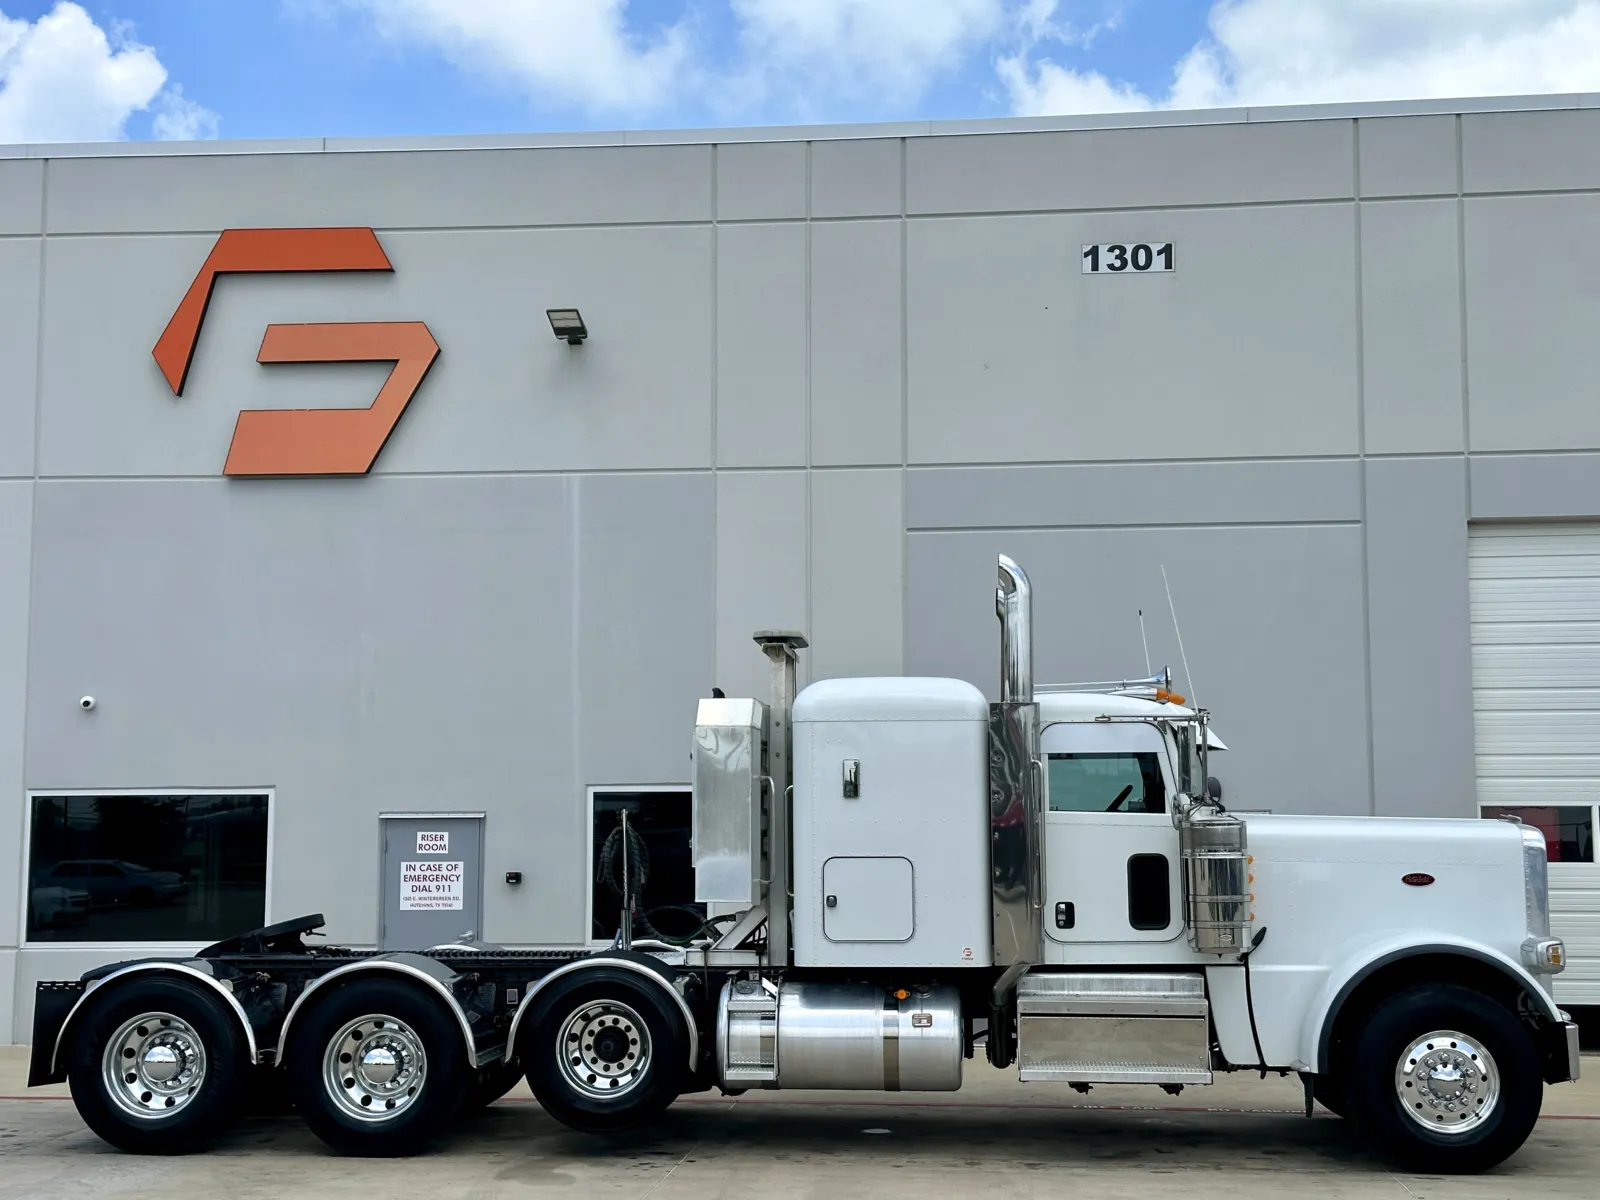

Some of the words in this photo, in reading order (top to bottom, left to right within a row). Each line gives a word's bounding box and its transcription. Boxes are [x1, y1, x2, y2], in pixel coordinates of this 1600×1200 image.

[1083, 243, 1173, 272] 1301
[421, 834, 445, 842] RISER
[418, 843, 447, 852] ROOM
[405, 864, 416, 872] IN
[419, 864, 443, 872] CASE
[445, 864, 459, 872] OF
[403, 874, 461, 882] EMERGENCY
[411, 884, 432, 893] DIAL
[435, 884, 451, 893] 911
